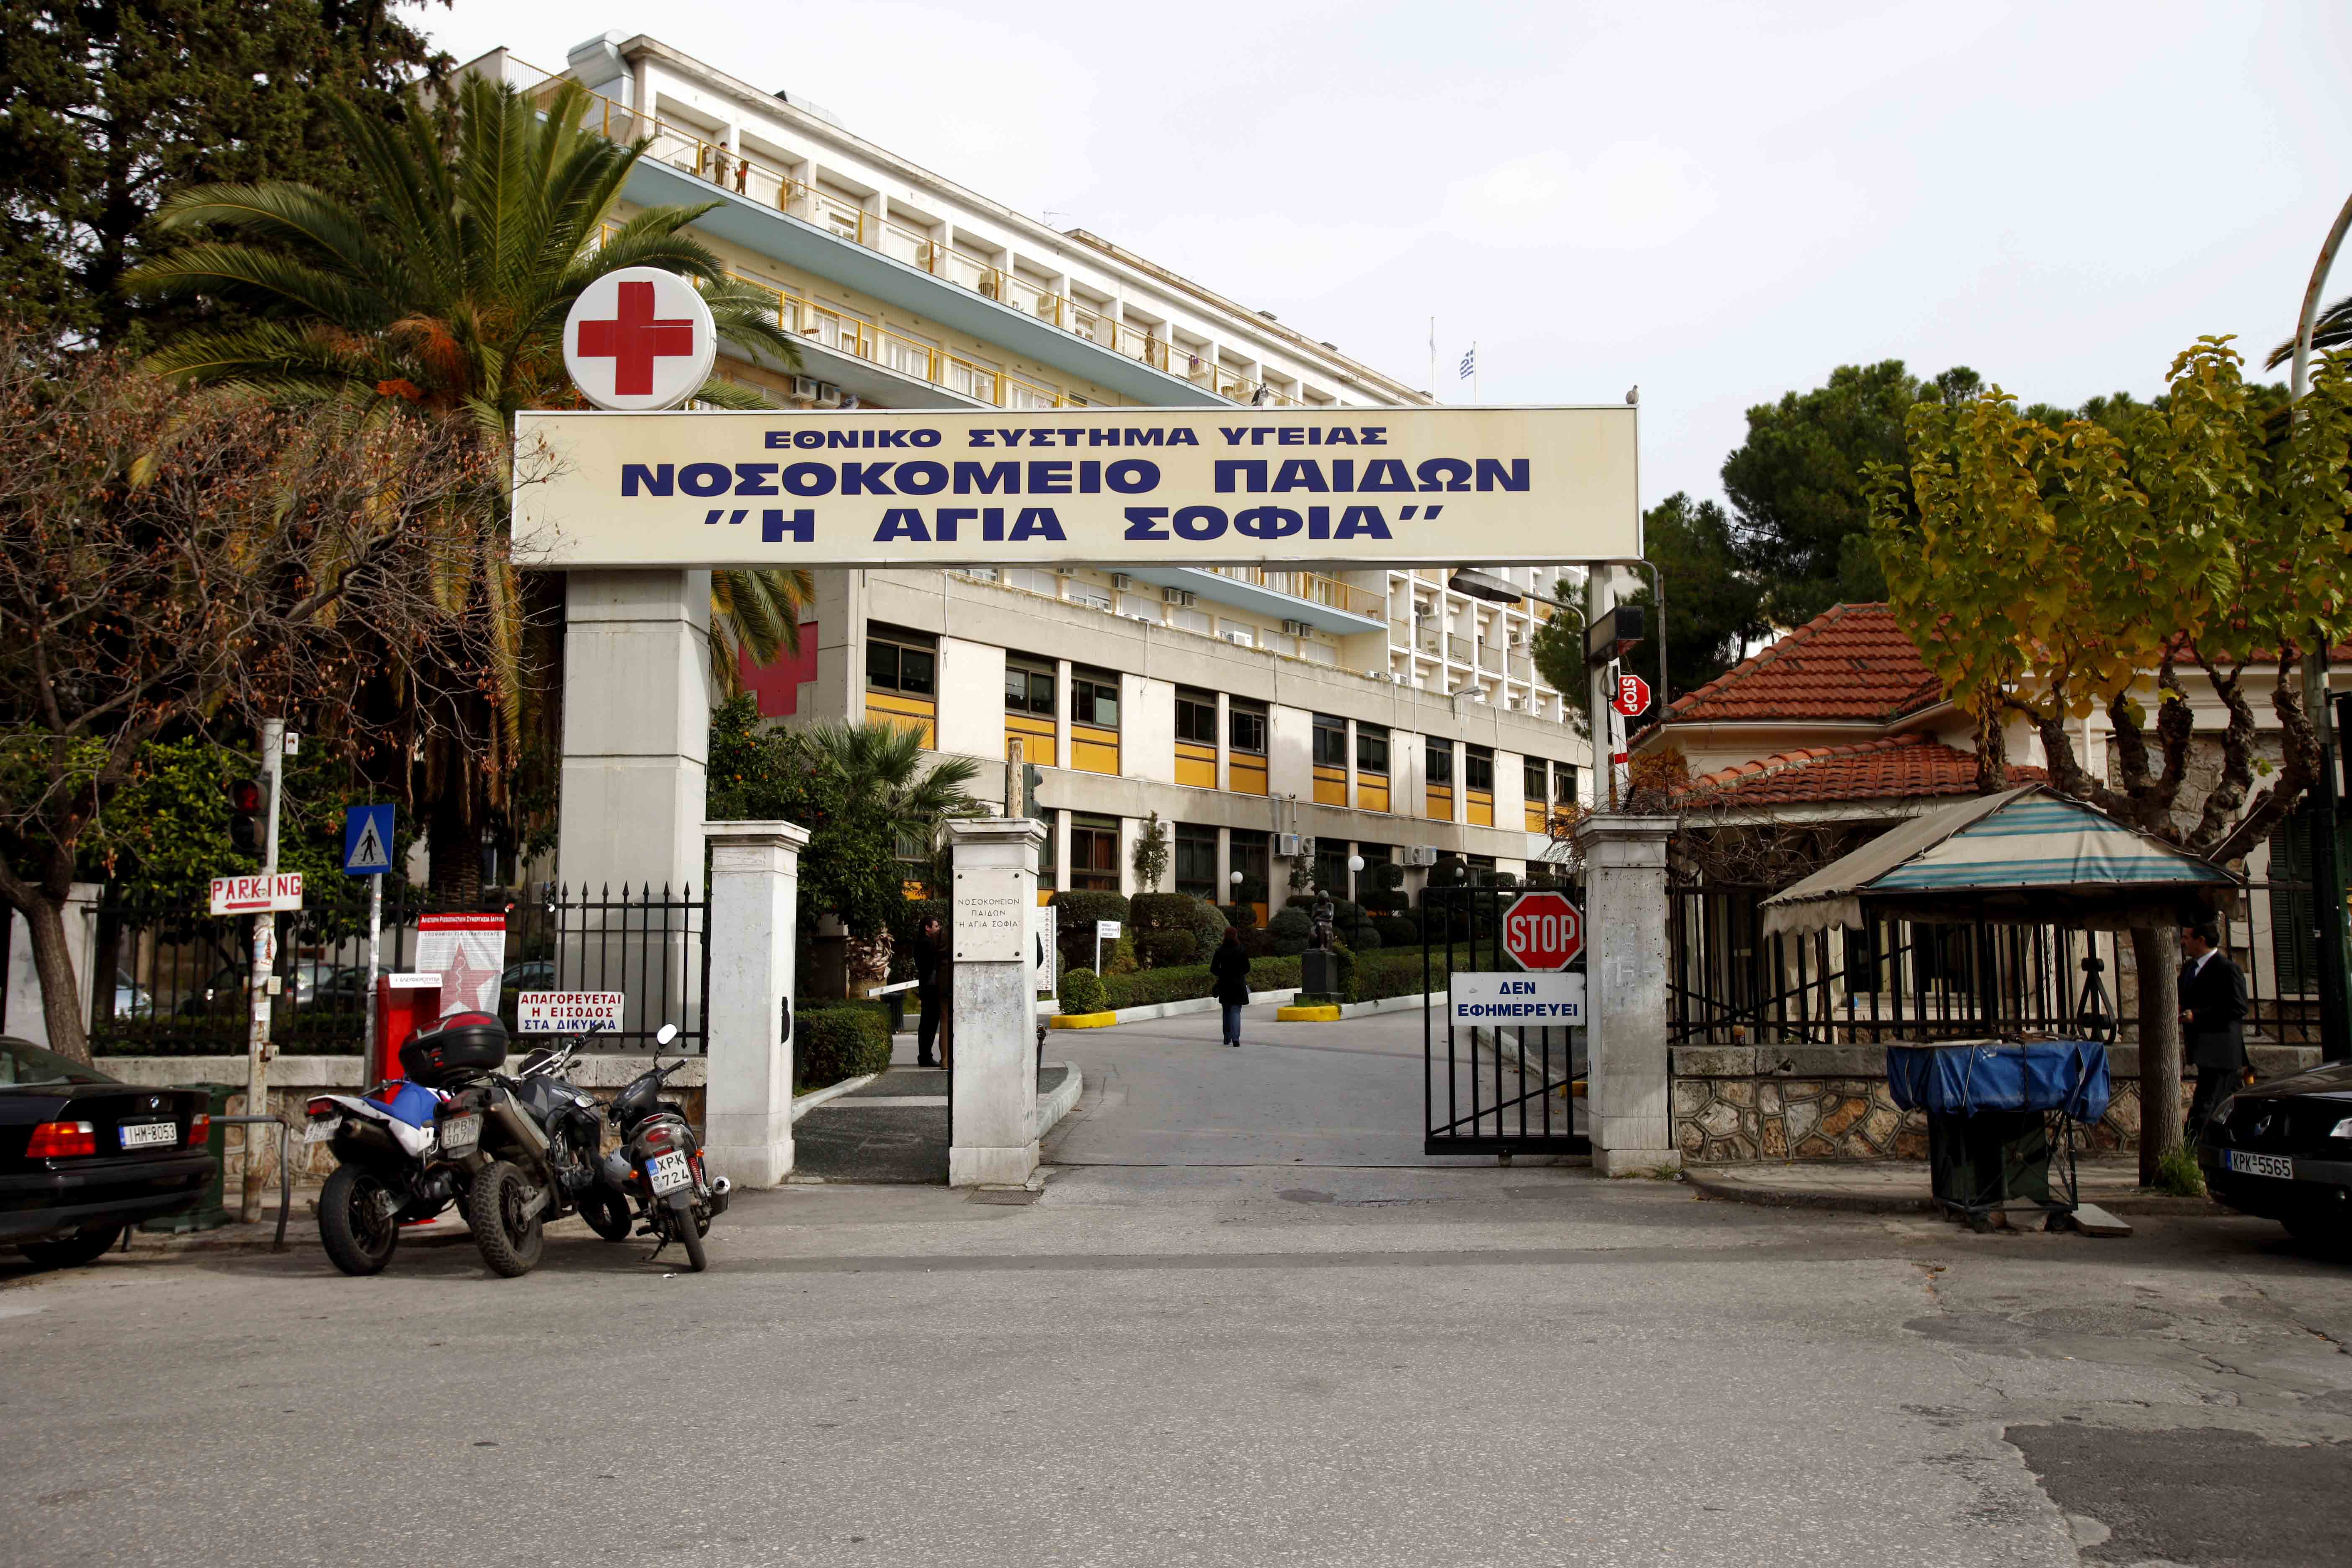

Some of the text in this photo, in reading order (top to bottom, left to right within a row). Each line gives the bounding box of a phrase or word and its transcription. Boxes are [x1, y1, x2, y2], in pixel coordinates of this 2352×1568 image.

[764, 427, 1387, 449] ΕΘΝΙΚΟ ΣΥΣΤΗΜΑ ΥΓΕΙΑΣ
[622, 457, 1530, 498] ΝΟΣΟΚΟΜΕΙΟ ΠΑΙΔΩΝ
[873, 508, 1067, 542] ΑΓΙΑ
[1622, 679, 1638, 712] STOP
[212, 876, 302, 901] PARKING
[1511, 915, 1575, 953] STOP
[1499, 982, 1536, 994] ΔΕΝ
[521, 994, 621, 1004] ΑΠΑΓΟΡΕΥΕΤΑΙ
[532, 1007, 613, 1017] Η ΕΙΣΟΔΟΣ
[1458, 1003, 1578, 1016] ΕΦΗΜΕΡΕΥΕΙ
[525, 1020, 549, 1030] ΣΤΑ
[445, 1132, 466, 1146] 307
[662, 1169, 689, 1186] 724
